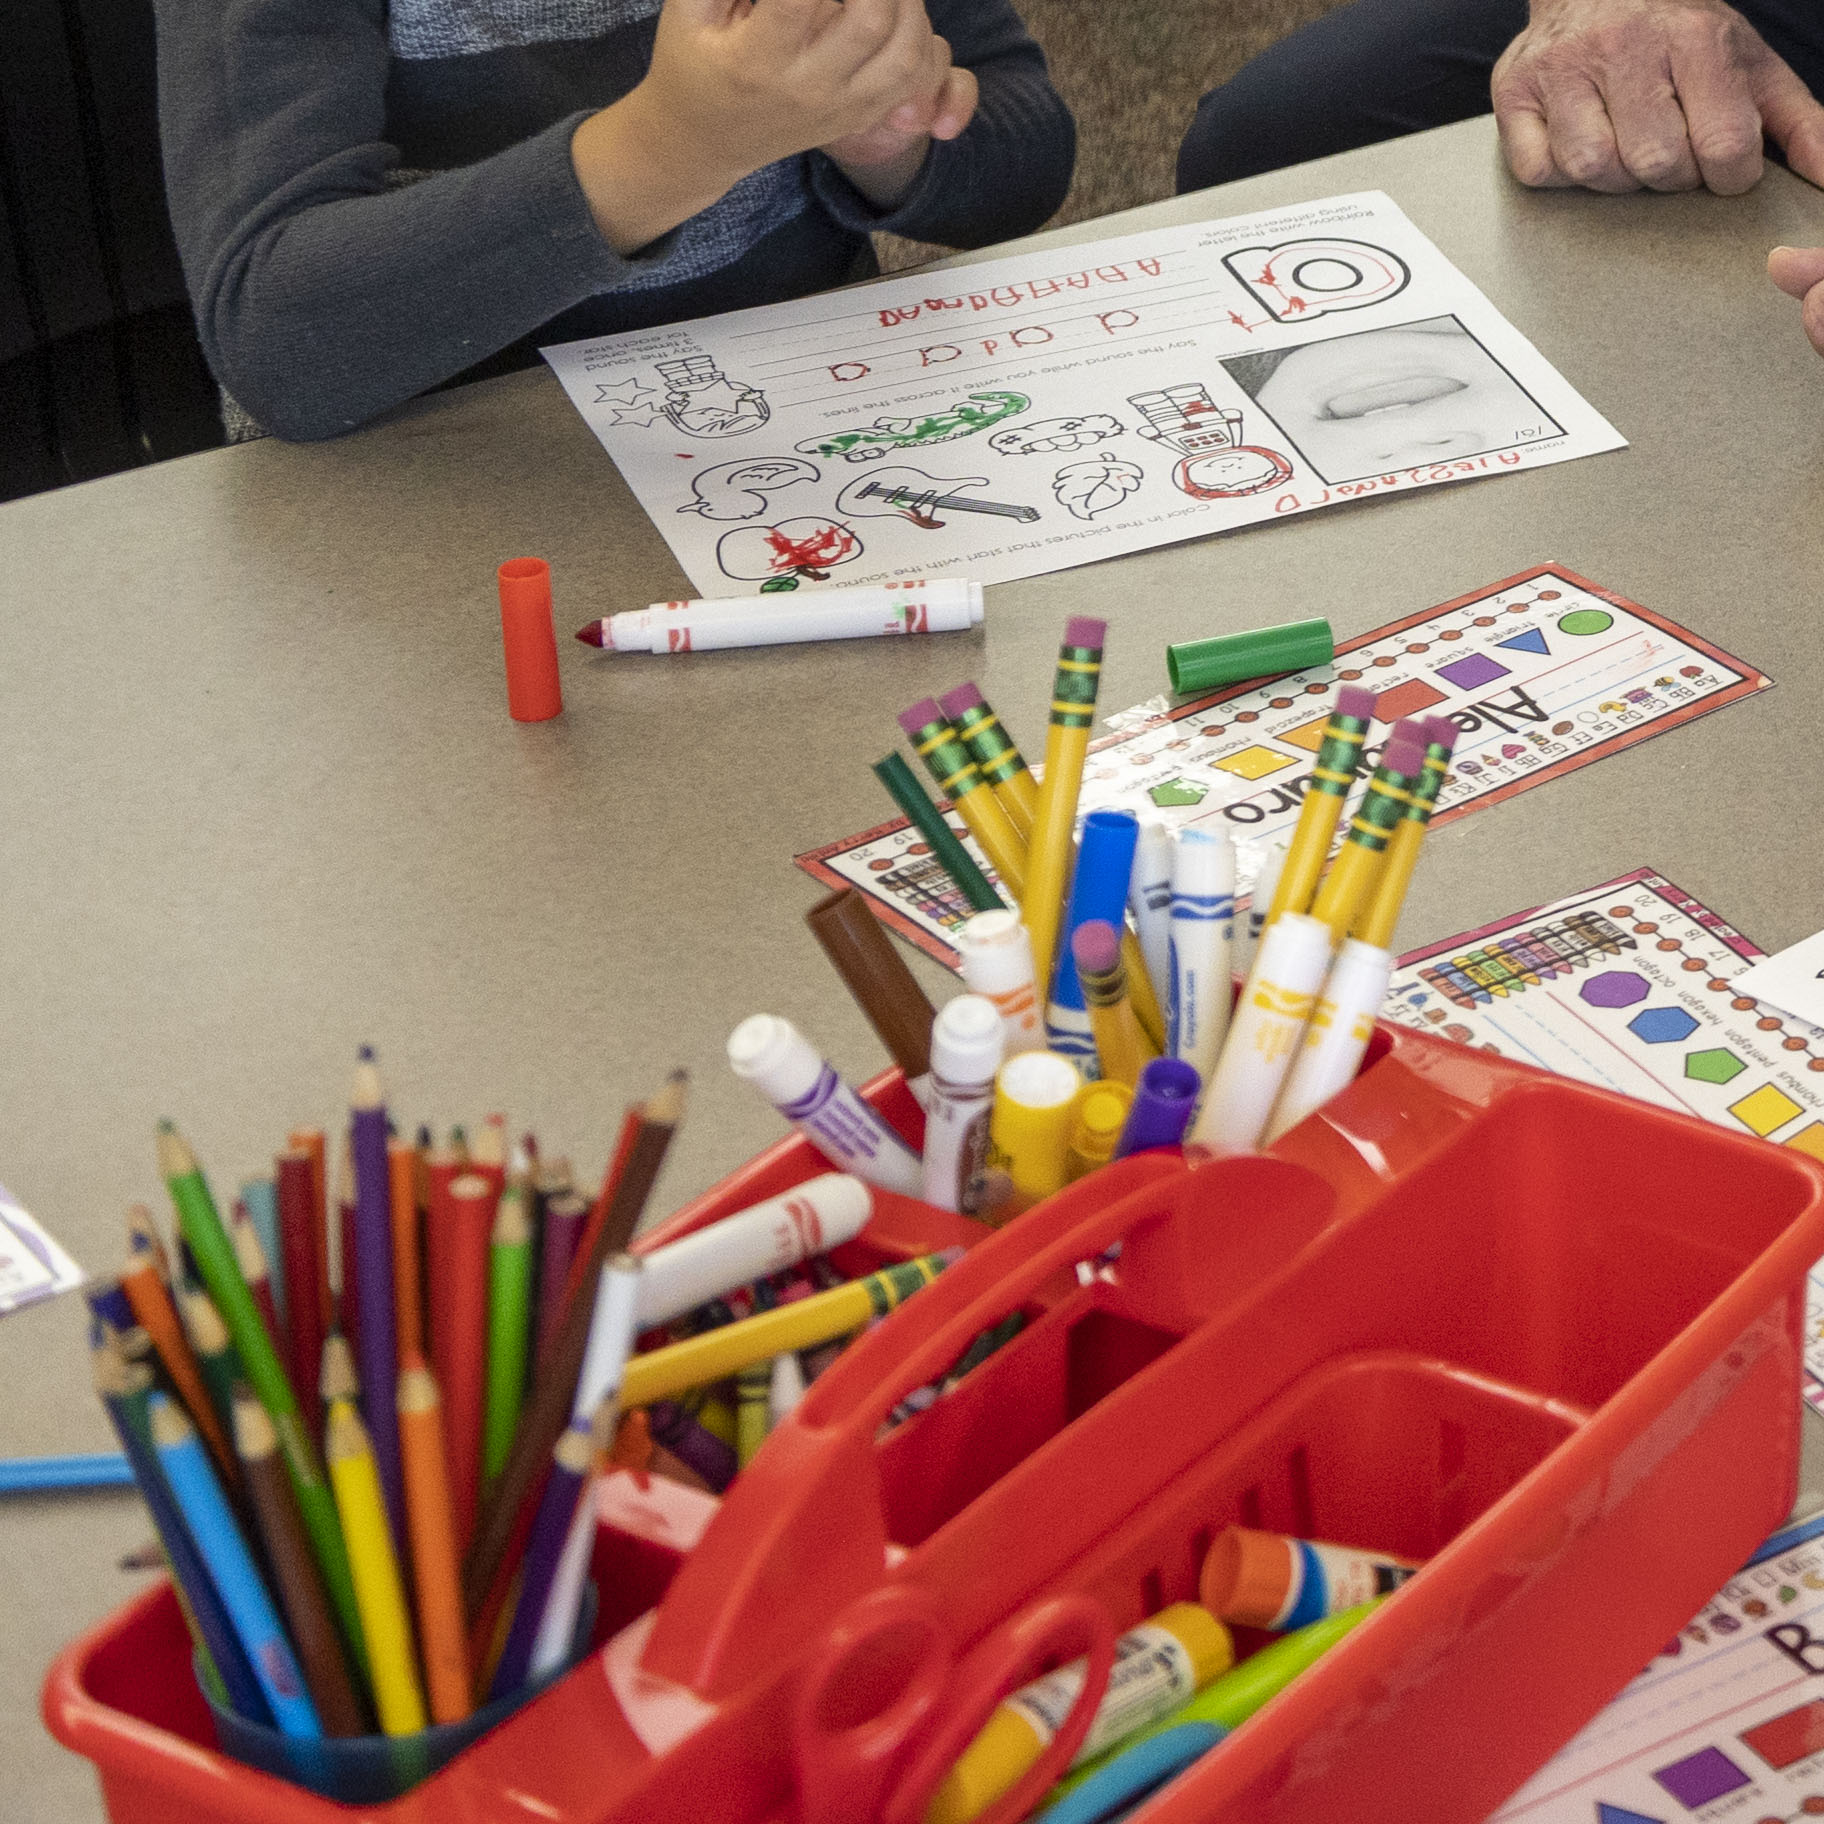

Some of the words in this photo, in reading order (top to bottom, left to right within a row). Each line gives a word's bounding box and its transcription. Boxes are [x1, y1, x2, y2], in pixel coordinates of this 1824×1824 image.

[1137, 345, 1163, 357] the
[1166, 336, 1197, 352] Say
[1084, 349, 1134, 367] sound
[1003, 367, 1036, 381] you
[1039, 359, 1081, 376] while
[948, 384, 961, 394] it
[962, 375, 1001, 391] write
[892, 386, 945, 404] across
[816, 403, 860, 421] lines.
[861, 398, 890, 412] the
[1146, 514, 1161, 524] in
[1165, 503, 1210, 519] Color
[1115, 518, 1142, 531] the
[1045, 525, 1110, 545] pictures
[966, 547, 1001, 562] start
[1006, 539, 1041, 554] that
[894, 564, 922, 577] the
[926, 556, 961, 570] with
[829, 571, 888, 590] sound.
[1524, 579, 1539, 593] 1
[1490, 592, 1506, 607] 2
[1458, 605, 1475, 620] 3
[1542, 597, 1582, 622] circle
[1423, 617, 1441, 633] 4
[1482, 614, 1537, 647] triangle
[1391, 631, 1408, 646] 5
[1357, 644, 1375, 660] 6
[1422, 641, 1475, 673] square
[1290, 672, 1308, 687] 8
[1257, 688, 1271, 701] 9
[1217, 697, 1240, 716] 10
[1182, 713, 1203, 730] 11
[1262, 700, 1332, 739] trapezoid
[1189, 732, 1252, 767] rhombus
[891, 829, 913, 846] 19
[847, 844, 874, 864] 20
[1631, 888, 1658, 913] 20
[1657, 906, 1682, 930] 19
[1682, 923, 1706, 946] 18
[1708, 944, 1730, 965] 17
[1627, 952, 1677, 993] octagon
[1671, 986, 1724, 1031] hexagon
[1719, 1024, 1778, 1072] pentagon
